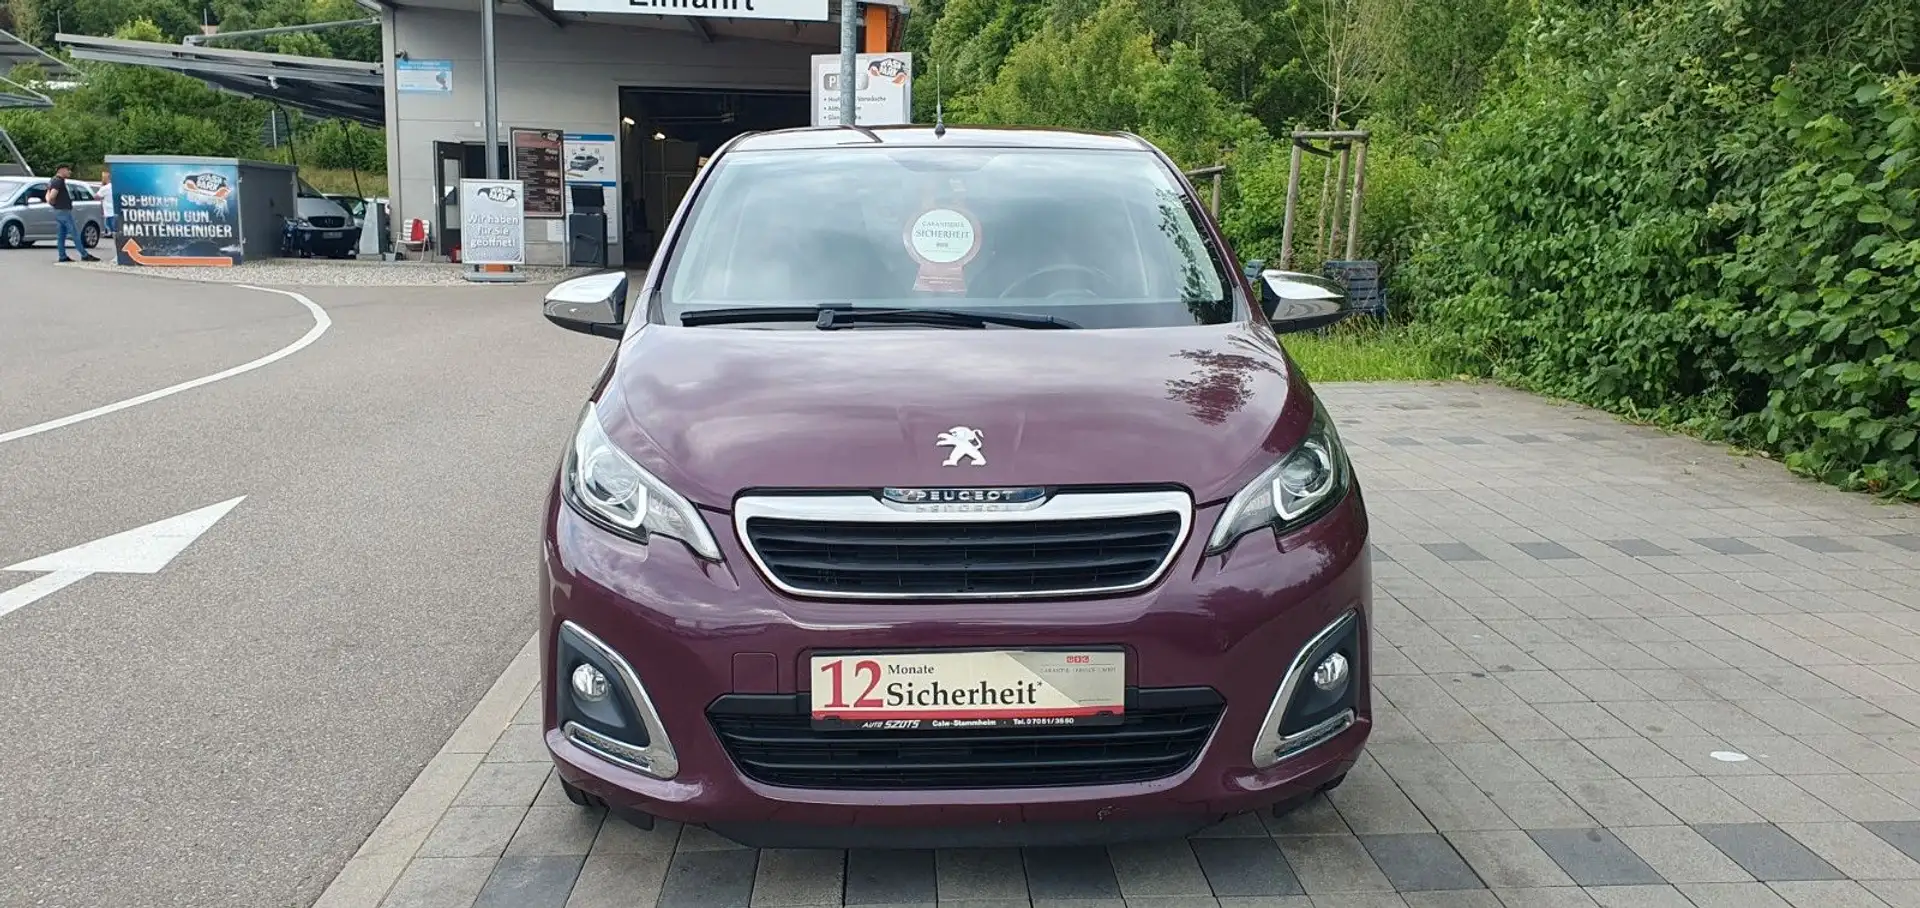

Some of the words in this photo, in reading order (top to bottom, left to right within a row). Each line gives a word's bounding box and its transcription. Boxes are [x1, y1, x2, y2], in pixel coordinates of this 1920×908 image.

[121, 195, 179, 208] SB-BOXEN
[122, 209, 181, 223] TORNADO
[468, 213, 486, 225] Wir
[488, 214, 519, 226] haben
[123, 223, 233, 238] MATTENREINIGER
[492, 226, 509, 236] Sie
[916, 230, 970, 239] SICHERHEIT
[915, 491, 1013, 501] PEUGEOT
[820, 660, 884, 708] 12
[888, 664, 935, 675] Monate
